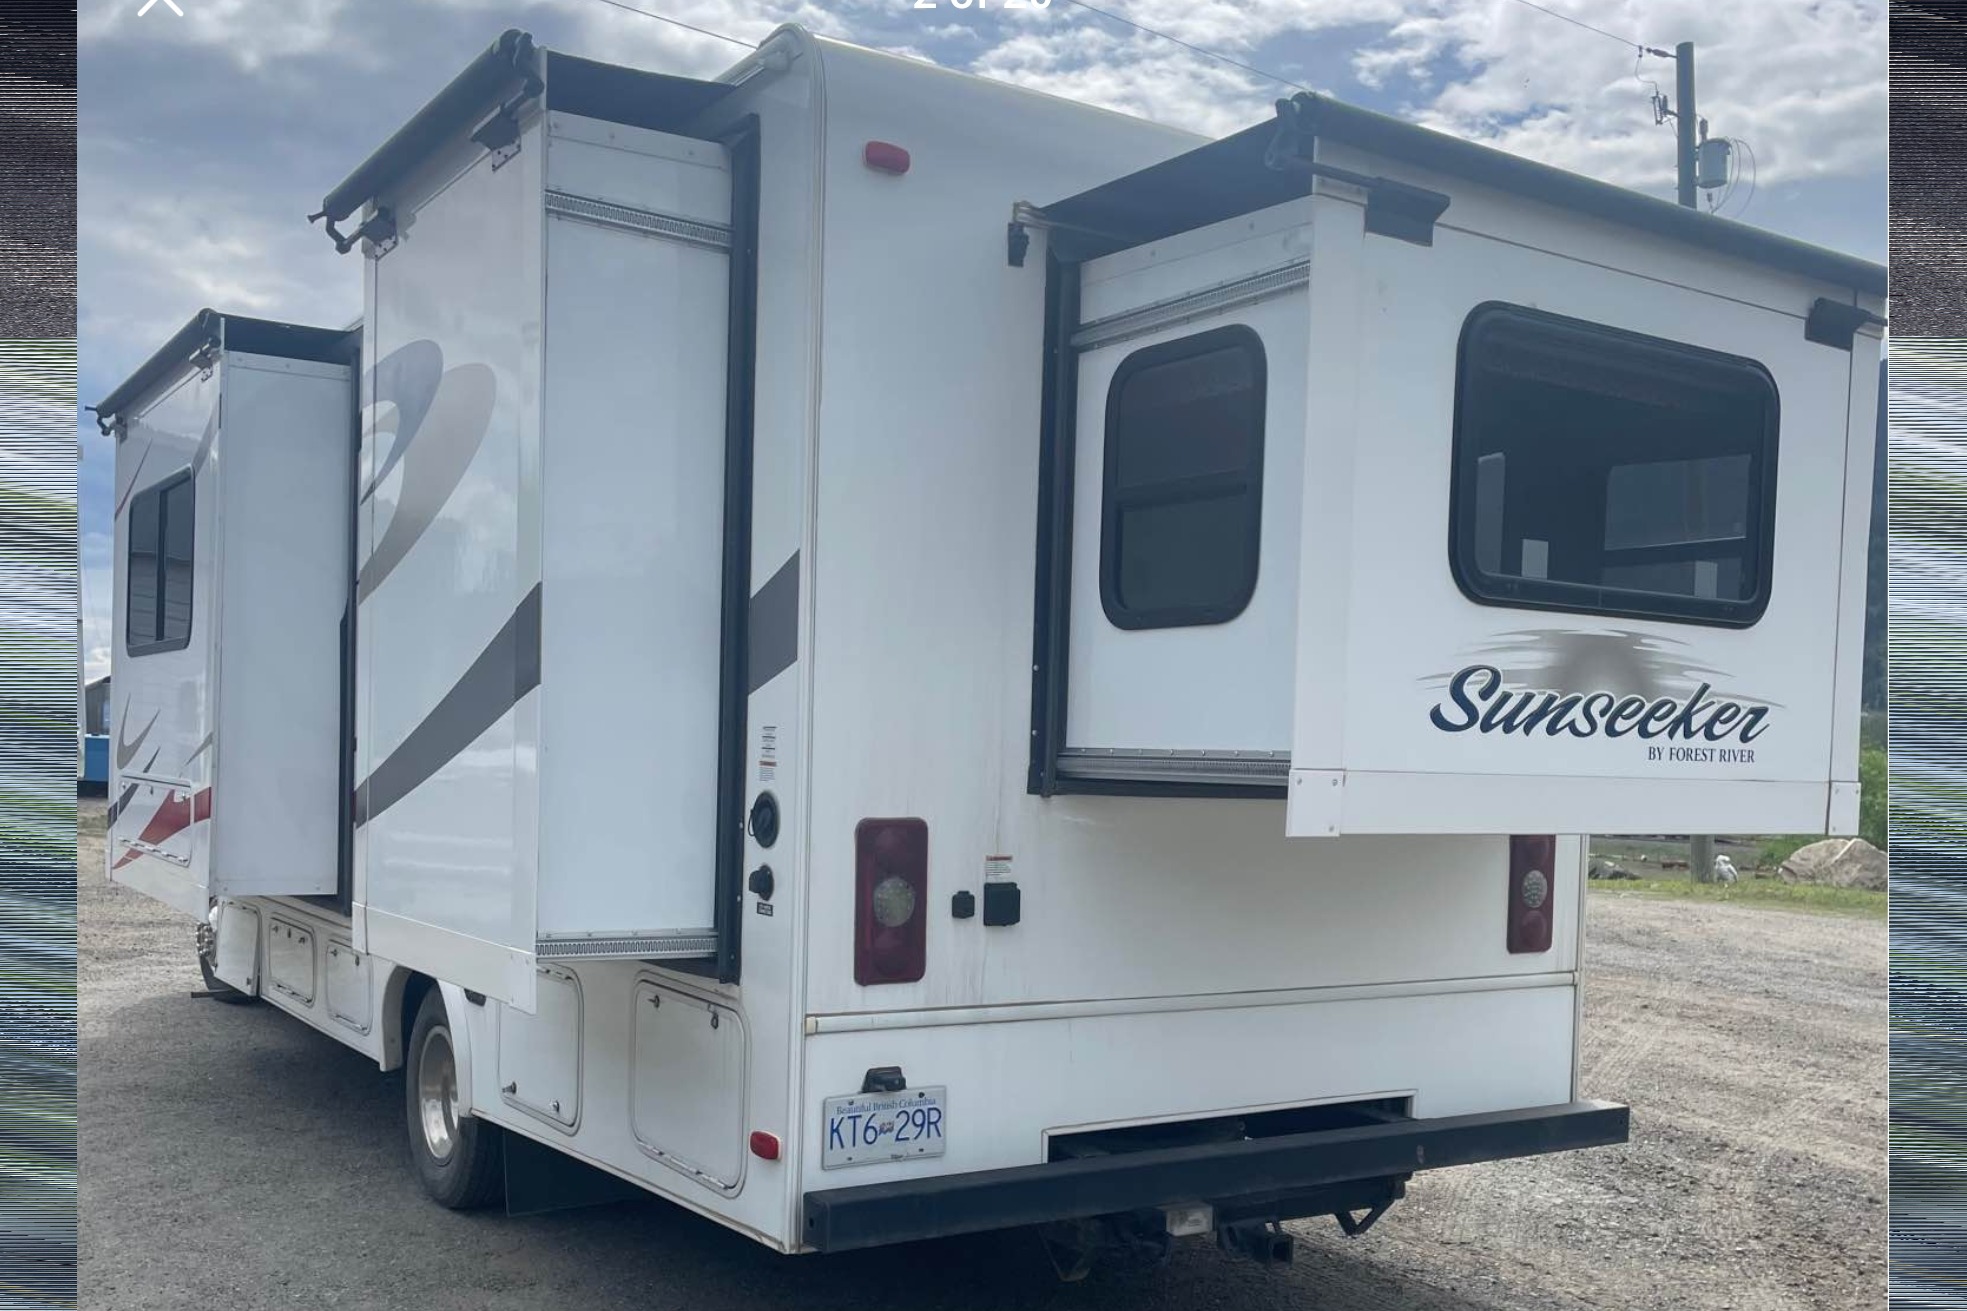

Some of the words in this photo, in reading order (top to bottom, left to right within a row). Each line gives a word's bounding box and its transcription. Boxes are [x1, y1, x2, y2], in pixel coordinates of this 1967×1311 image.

[1429, 664, 1770, 744] Sunseeker
[1648, 746, 1664, 761] BY
[1669, 747, 1716, 762] FOREST
[1719, 748, 1755, 763] RIVER
[873, 1100, 897, 1112] British
[899, 1096, 936, 1109] Columbia
[829, 1112, 877, 1150] KT6
[895, 1106, 942, 1142] 29R
